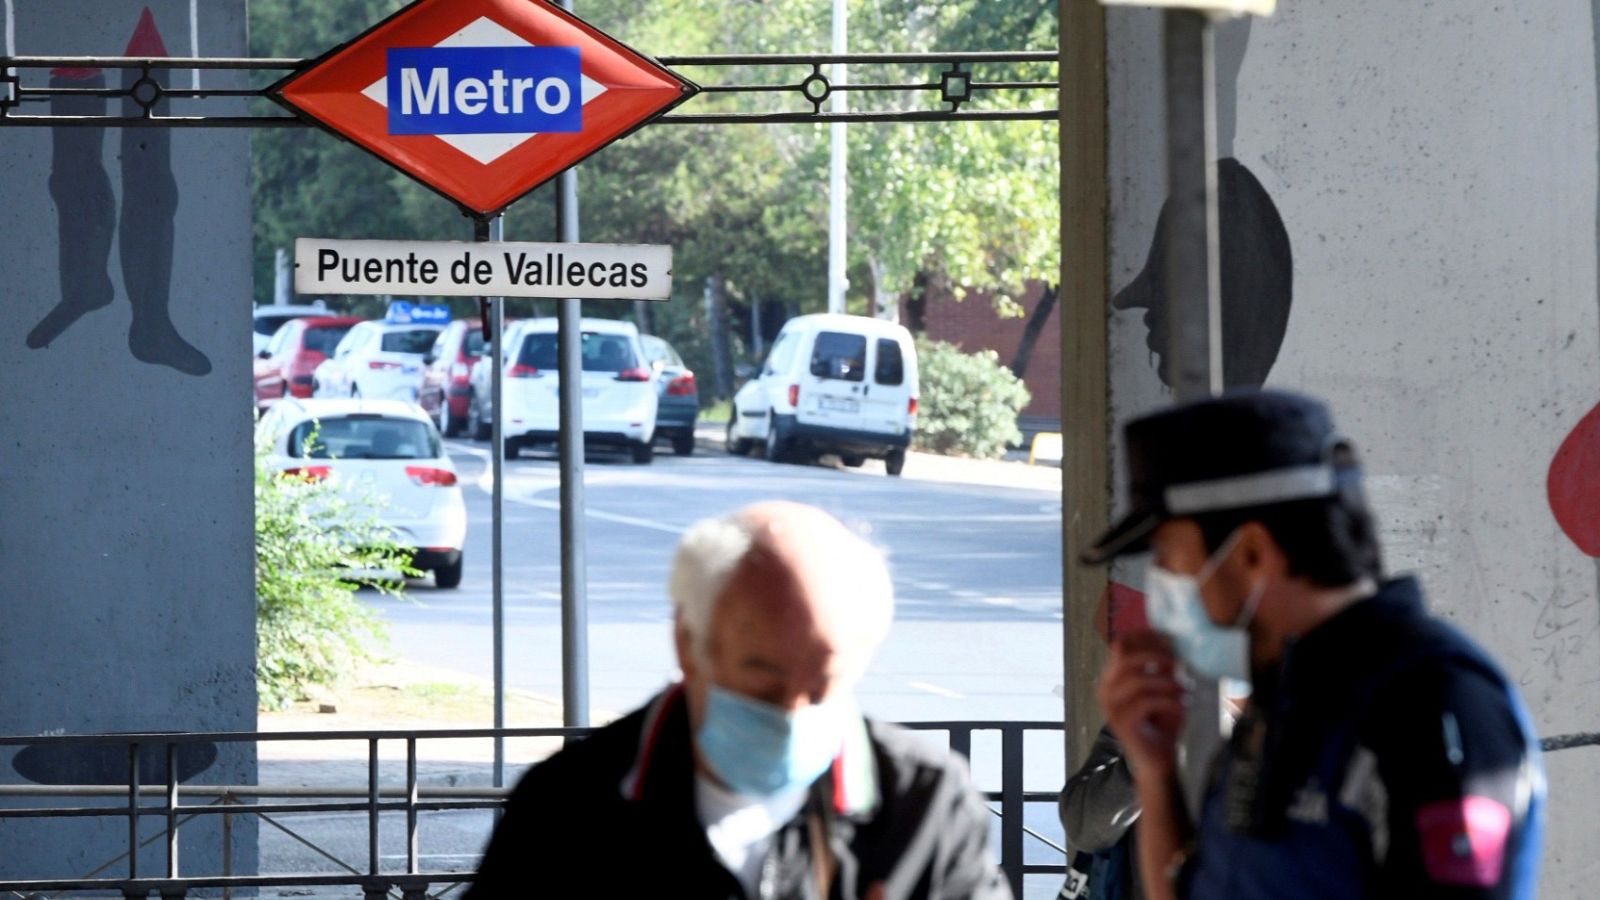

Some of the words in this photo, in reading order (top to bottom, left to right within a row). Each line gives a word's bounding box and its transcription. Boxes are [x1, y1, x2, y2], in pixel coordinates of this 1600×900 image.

[401, 67, 571, 115] Metro
[318, 248, 438, 285] Puente
[451, 252, 493, 285] de
[504, 253, 648, 288] Vallecas
